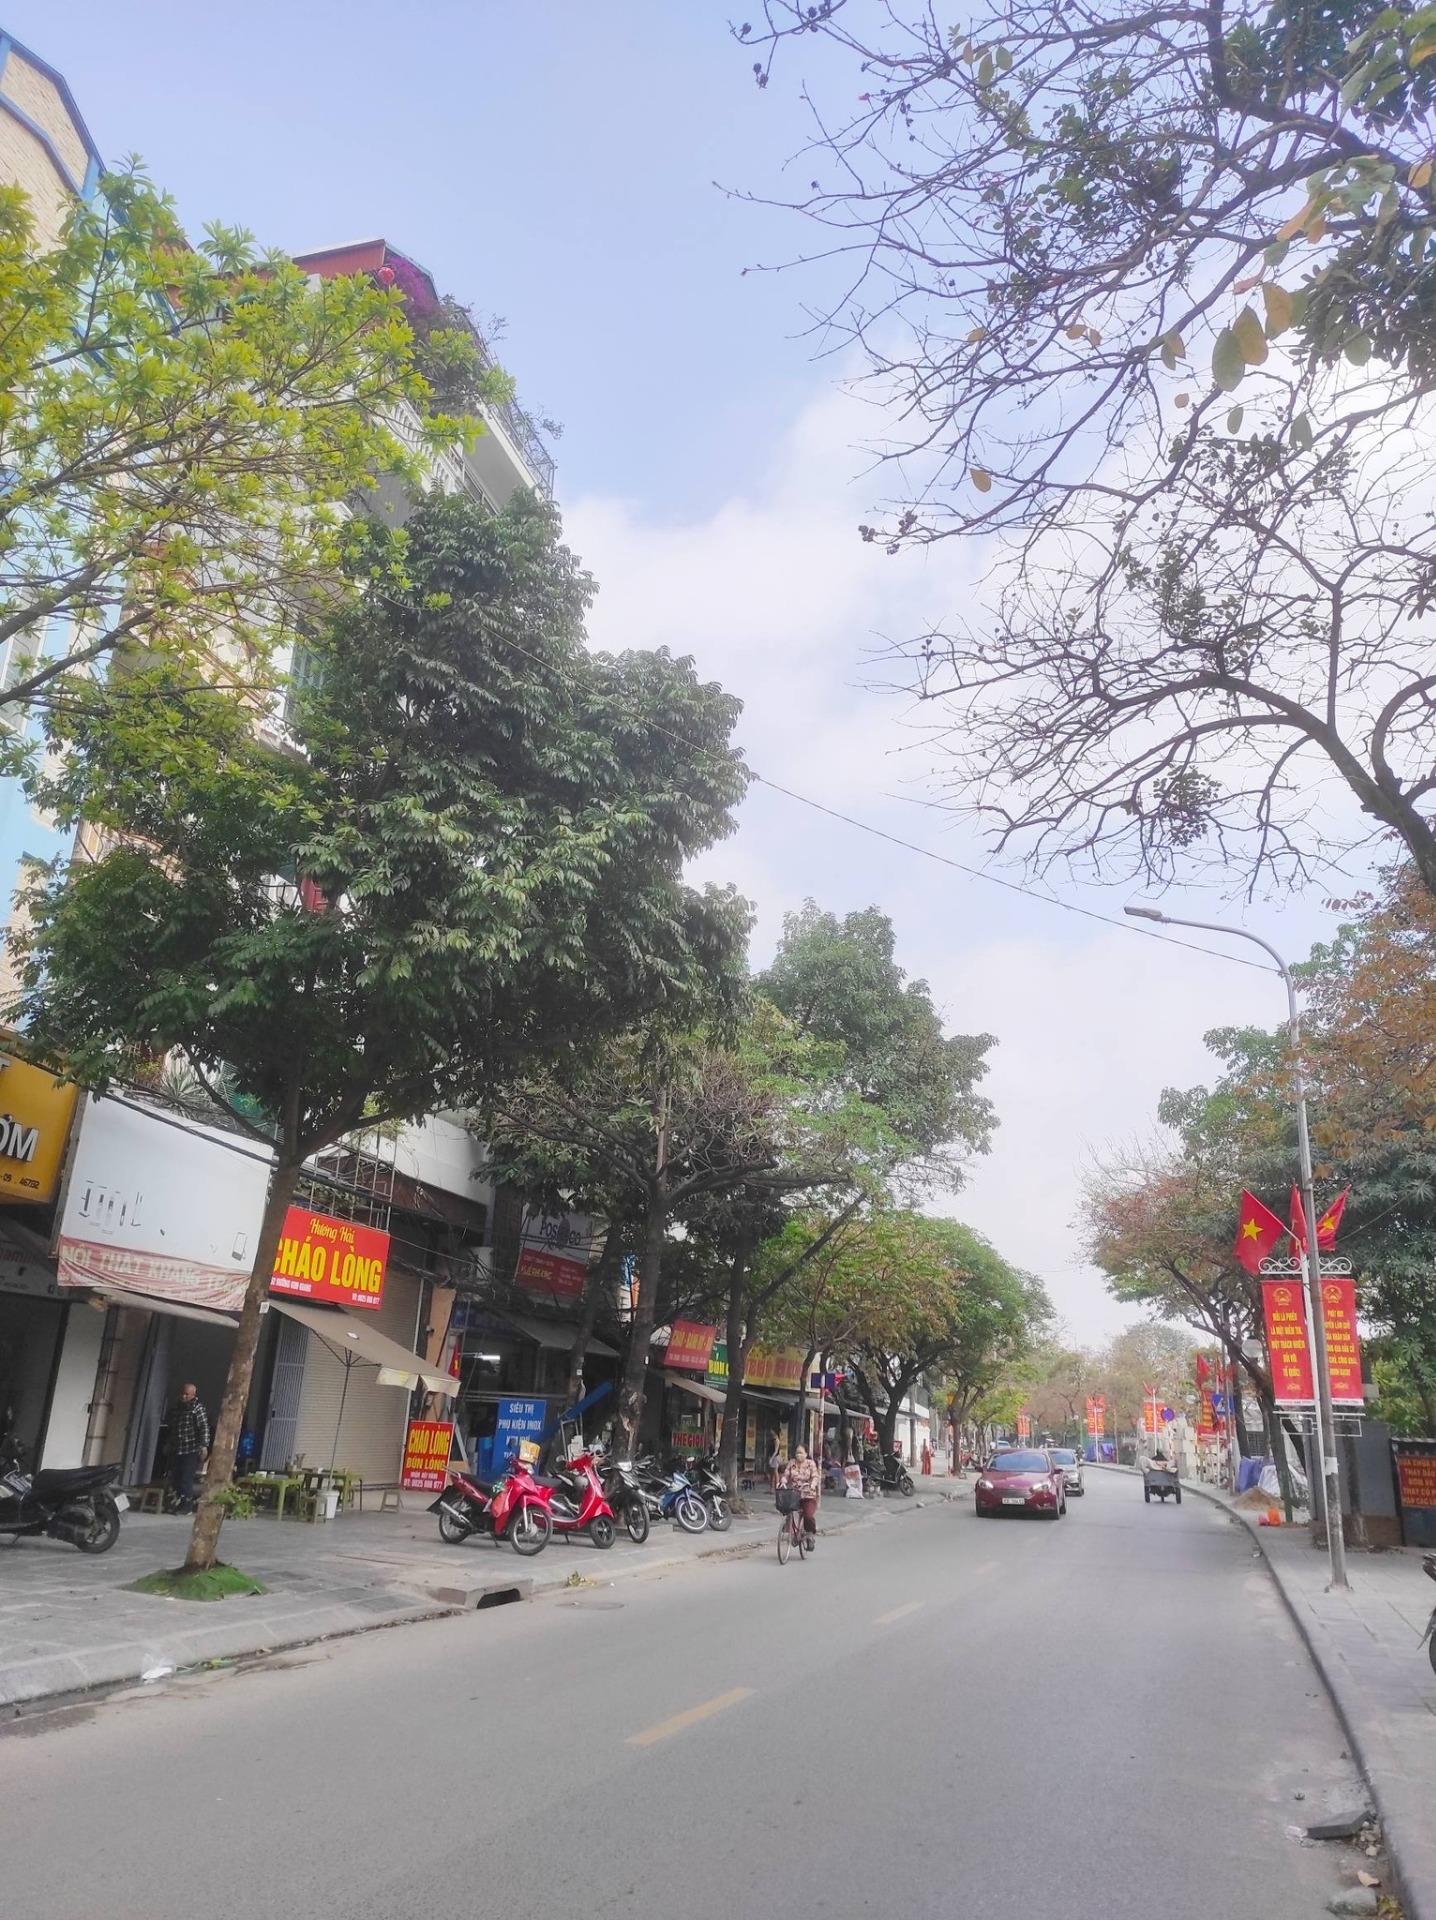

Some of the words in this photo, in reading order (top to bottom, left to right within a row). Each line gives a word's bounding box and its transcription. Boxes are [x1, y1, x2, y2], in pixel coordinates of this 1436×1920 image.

[329, 1245, 382, 1293] LÒNG
[509, 1402, 524, 1414] SIÊU
[524, 1403, 535, 1416] THỊ
[498, 1418, 511, 1432] PHỤ
[511, 1417, 527, 1431] KIỆN
[527, 1419, 542, 1431] INOX
[408, 1424, 430, 1454] CHÁO
[429, 1424, 451, 1456] LÒNG
[406, 1455, 423, 1469] BÚN
[424, 1456, 446, 1471] LÒNG
